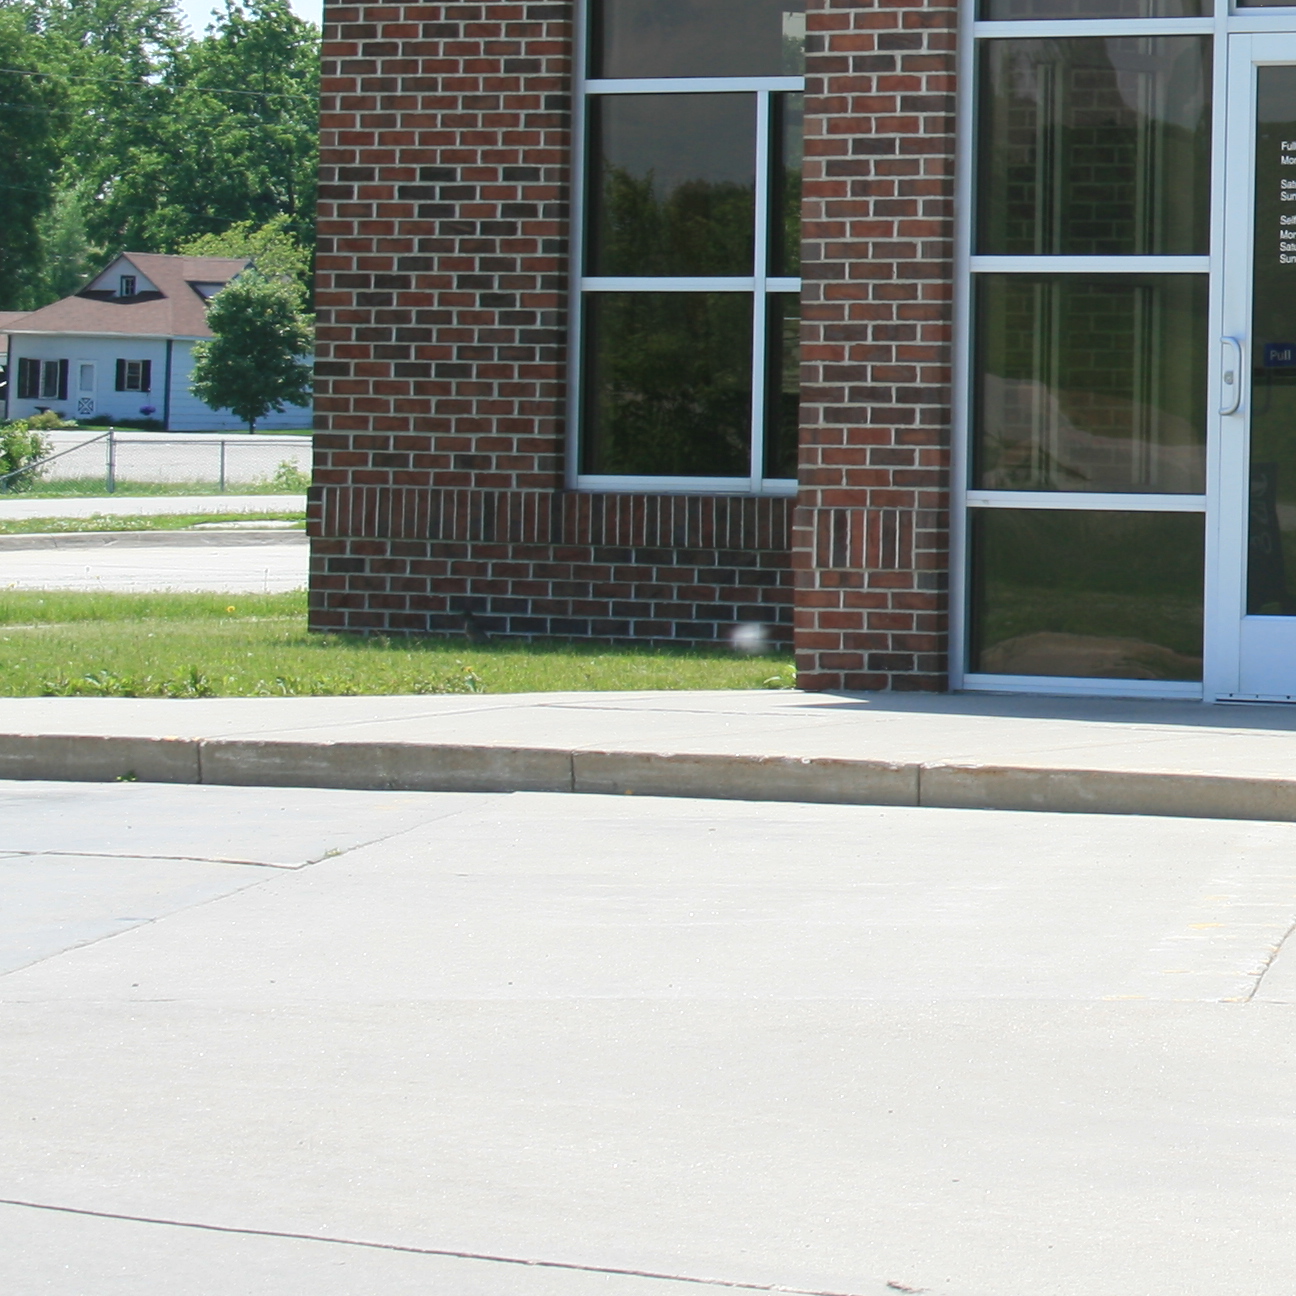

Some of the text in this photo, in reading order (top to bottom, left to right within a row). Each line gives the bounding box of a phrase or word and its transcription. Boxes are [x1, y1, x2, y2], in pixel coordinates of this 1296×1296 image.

[1281, 141, 1296, 151] Full
[1280, 215, 1296, 225] Self
[1270, 349, 1291, 361] Pull
